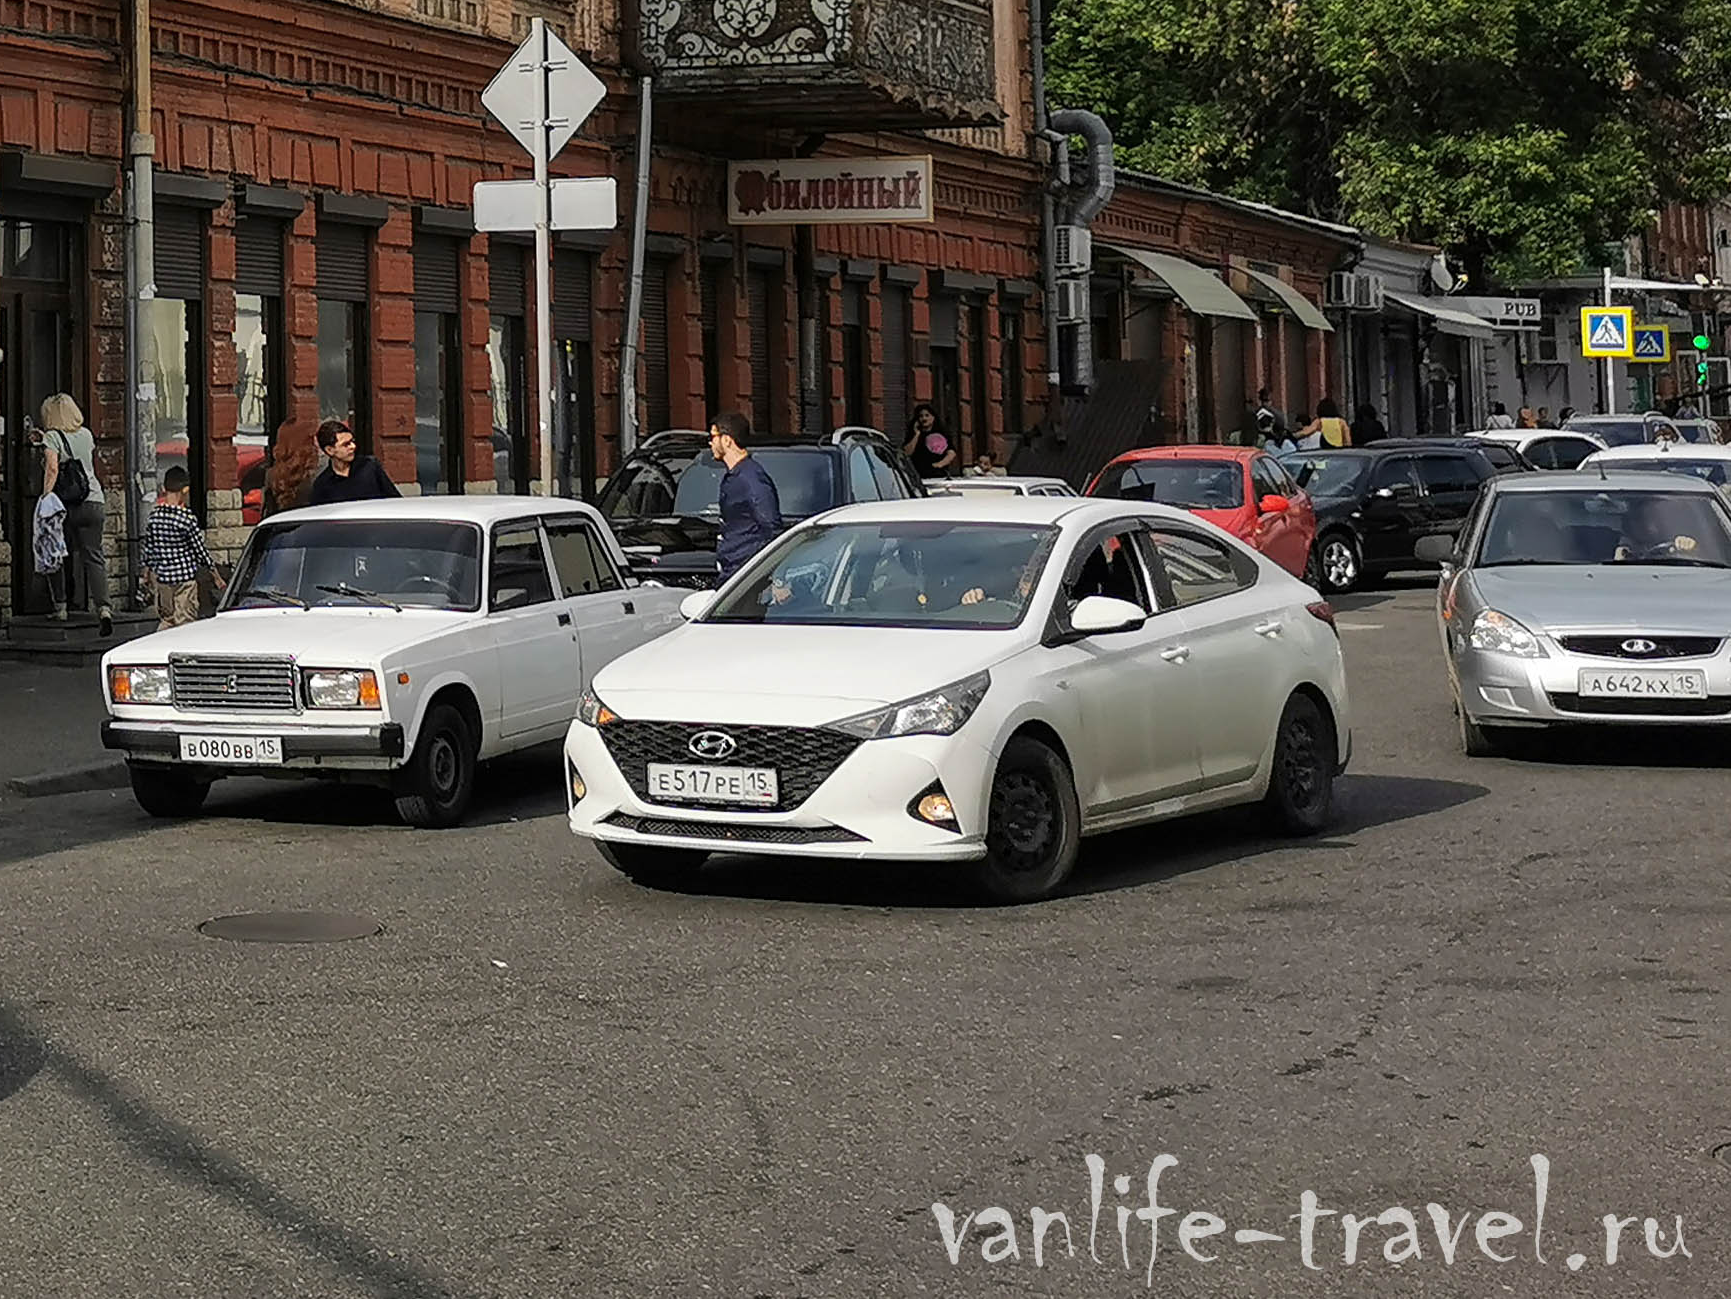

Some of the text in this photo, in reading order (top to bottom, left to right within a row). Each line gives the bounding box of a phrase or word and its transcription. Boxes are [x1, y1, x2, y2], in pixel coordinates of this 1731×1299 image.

[735, 170, 922, 216] билейный
[1504, 301, 1537, 317] PUB
[1591, 674, 1695, 693] А642КХ 15
[187, 739, 276, 759] В080ВВ 15
[658, 769, 768, 795] Е517РЕ 15
